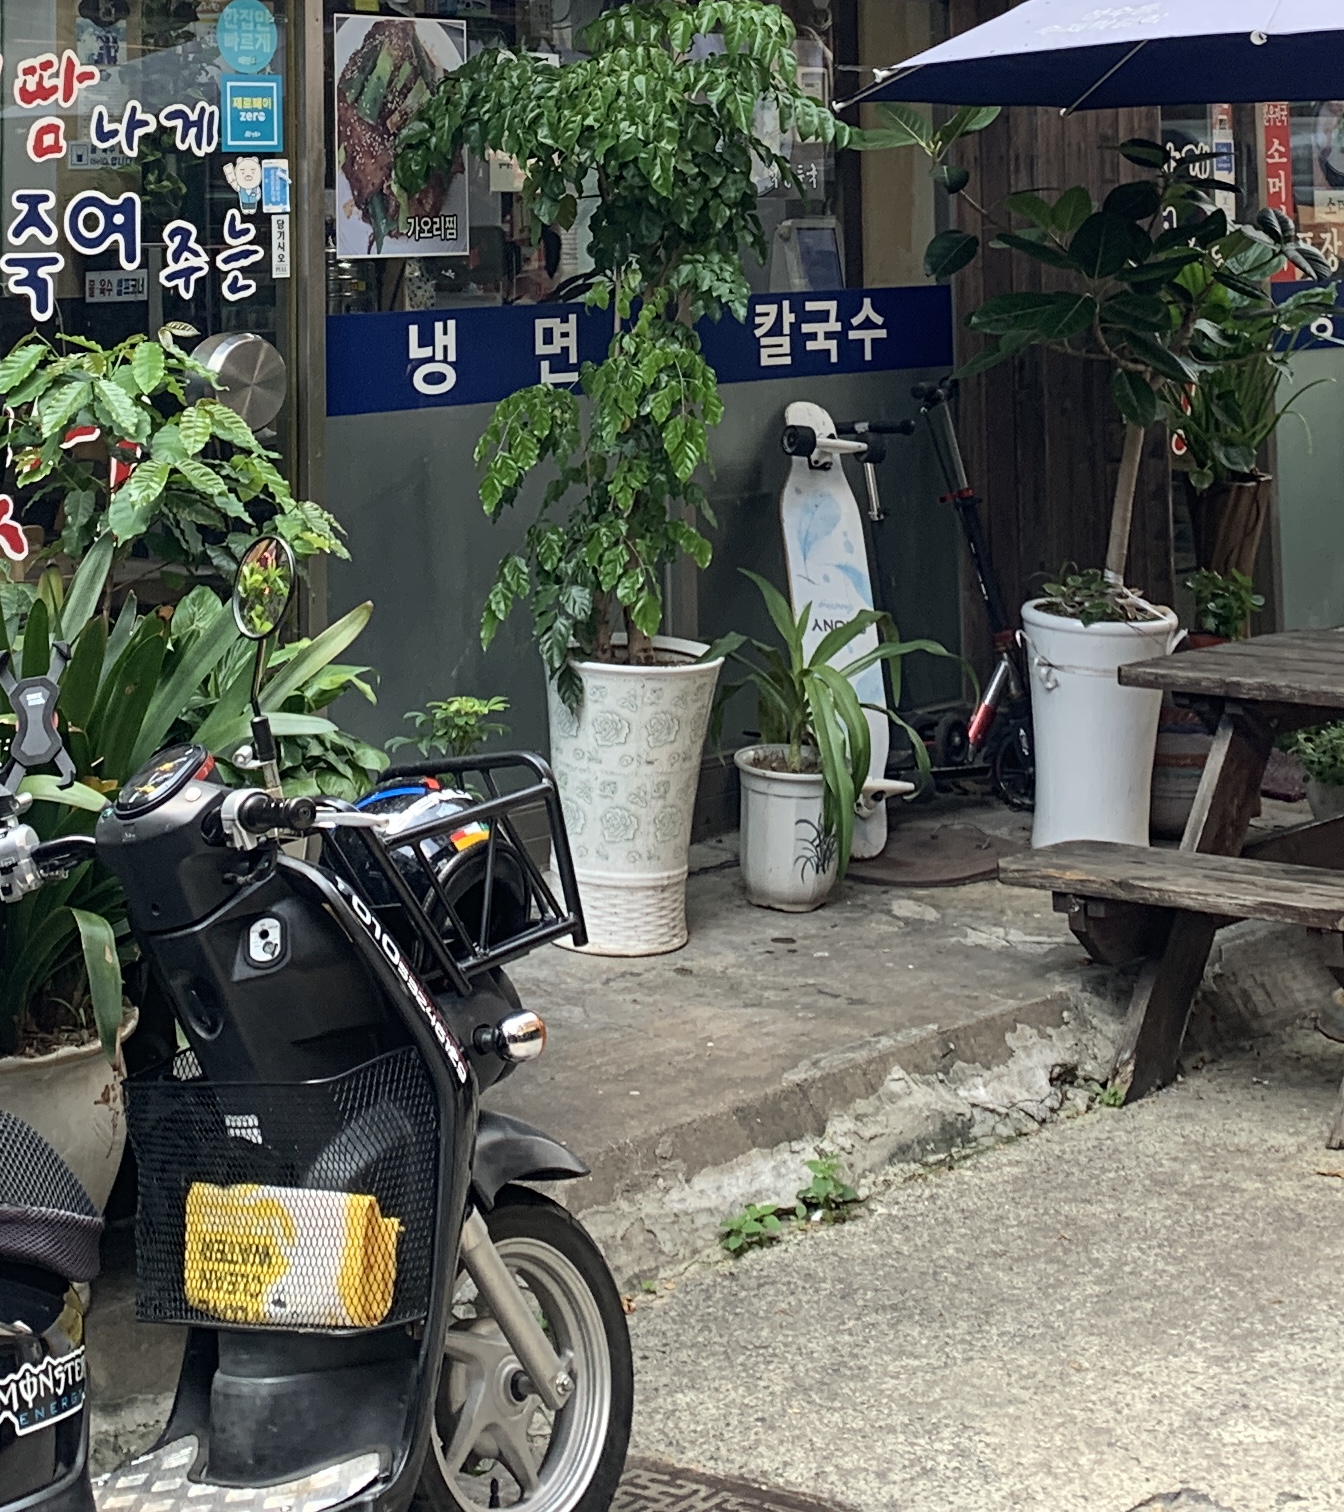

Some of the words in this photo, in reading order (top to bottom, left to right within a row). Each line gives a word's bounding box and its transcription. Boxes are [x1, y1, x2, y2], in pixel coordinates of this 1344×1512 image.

[276, 218, 286, 263] 당기시오
[406, 214, 458, 241] 가오리찜
[753, 297, 888, 367] 칼국수
